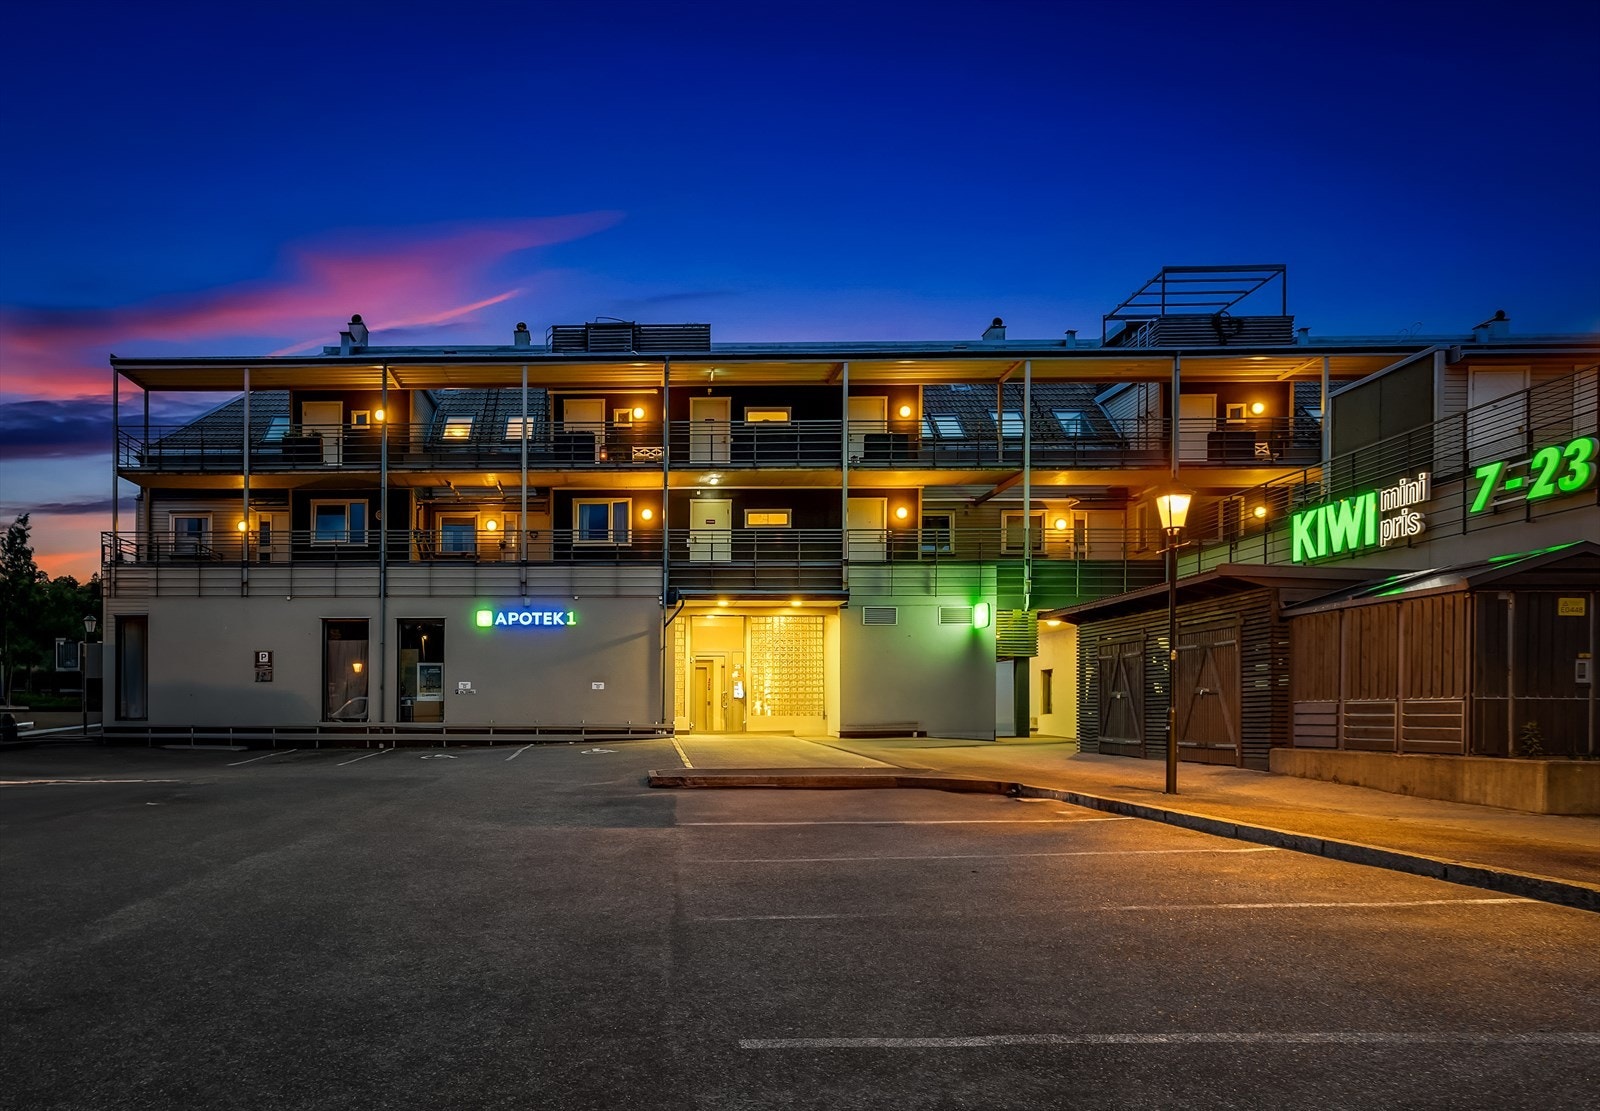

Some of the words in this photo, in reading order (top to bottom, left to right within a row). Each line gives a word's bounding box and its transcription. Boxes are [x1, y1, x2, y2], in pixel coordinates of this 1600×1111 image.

[1380, 472, 1429, 511] mini
[1470, 437, 1598, 513] 7-23
[1292, 491, 1377, 564] KIWI
[1380, 508, 1423, 547] pris
